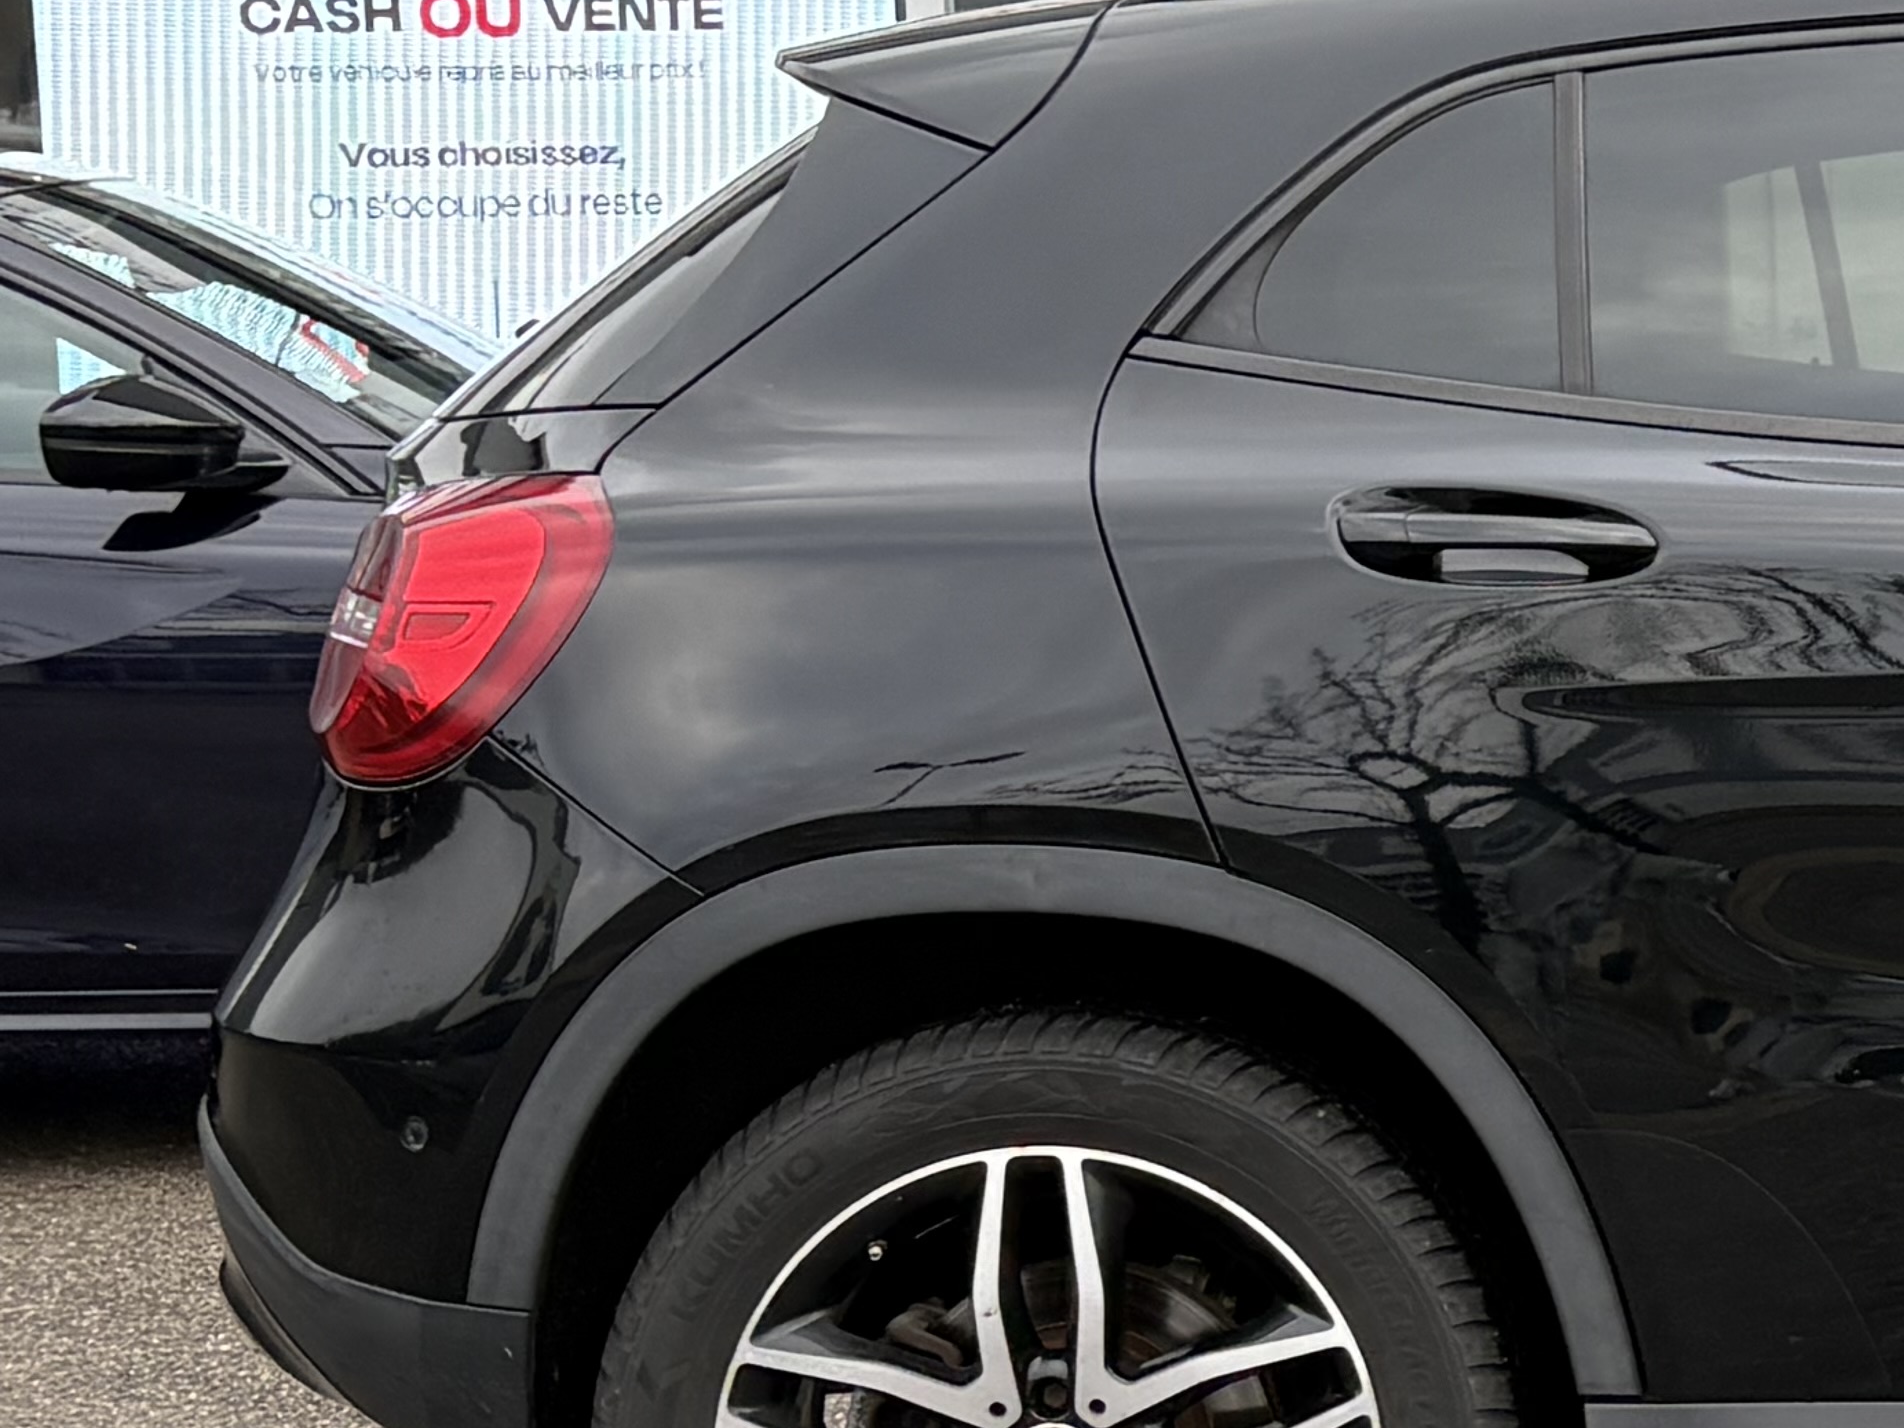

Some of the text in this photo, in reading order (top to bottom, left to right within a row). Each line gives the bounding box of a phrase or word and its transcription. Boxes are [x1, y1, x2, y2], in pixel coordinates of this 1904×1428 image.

[338, 139, 626, 170] Vous choisissez,
[309, 186, 663, 222] On s'occupe du reste
[672, 1146, 824, 1324] KUMHO
